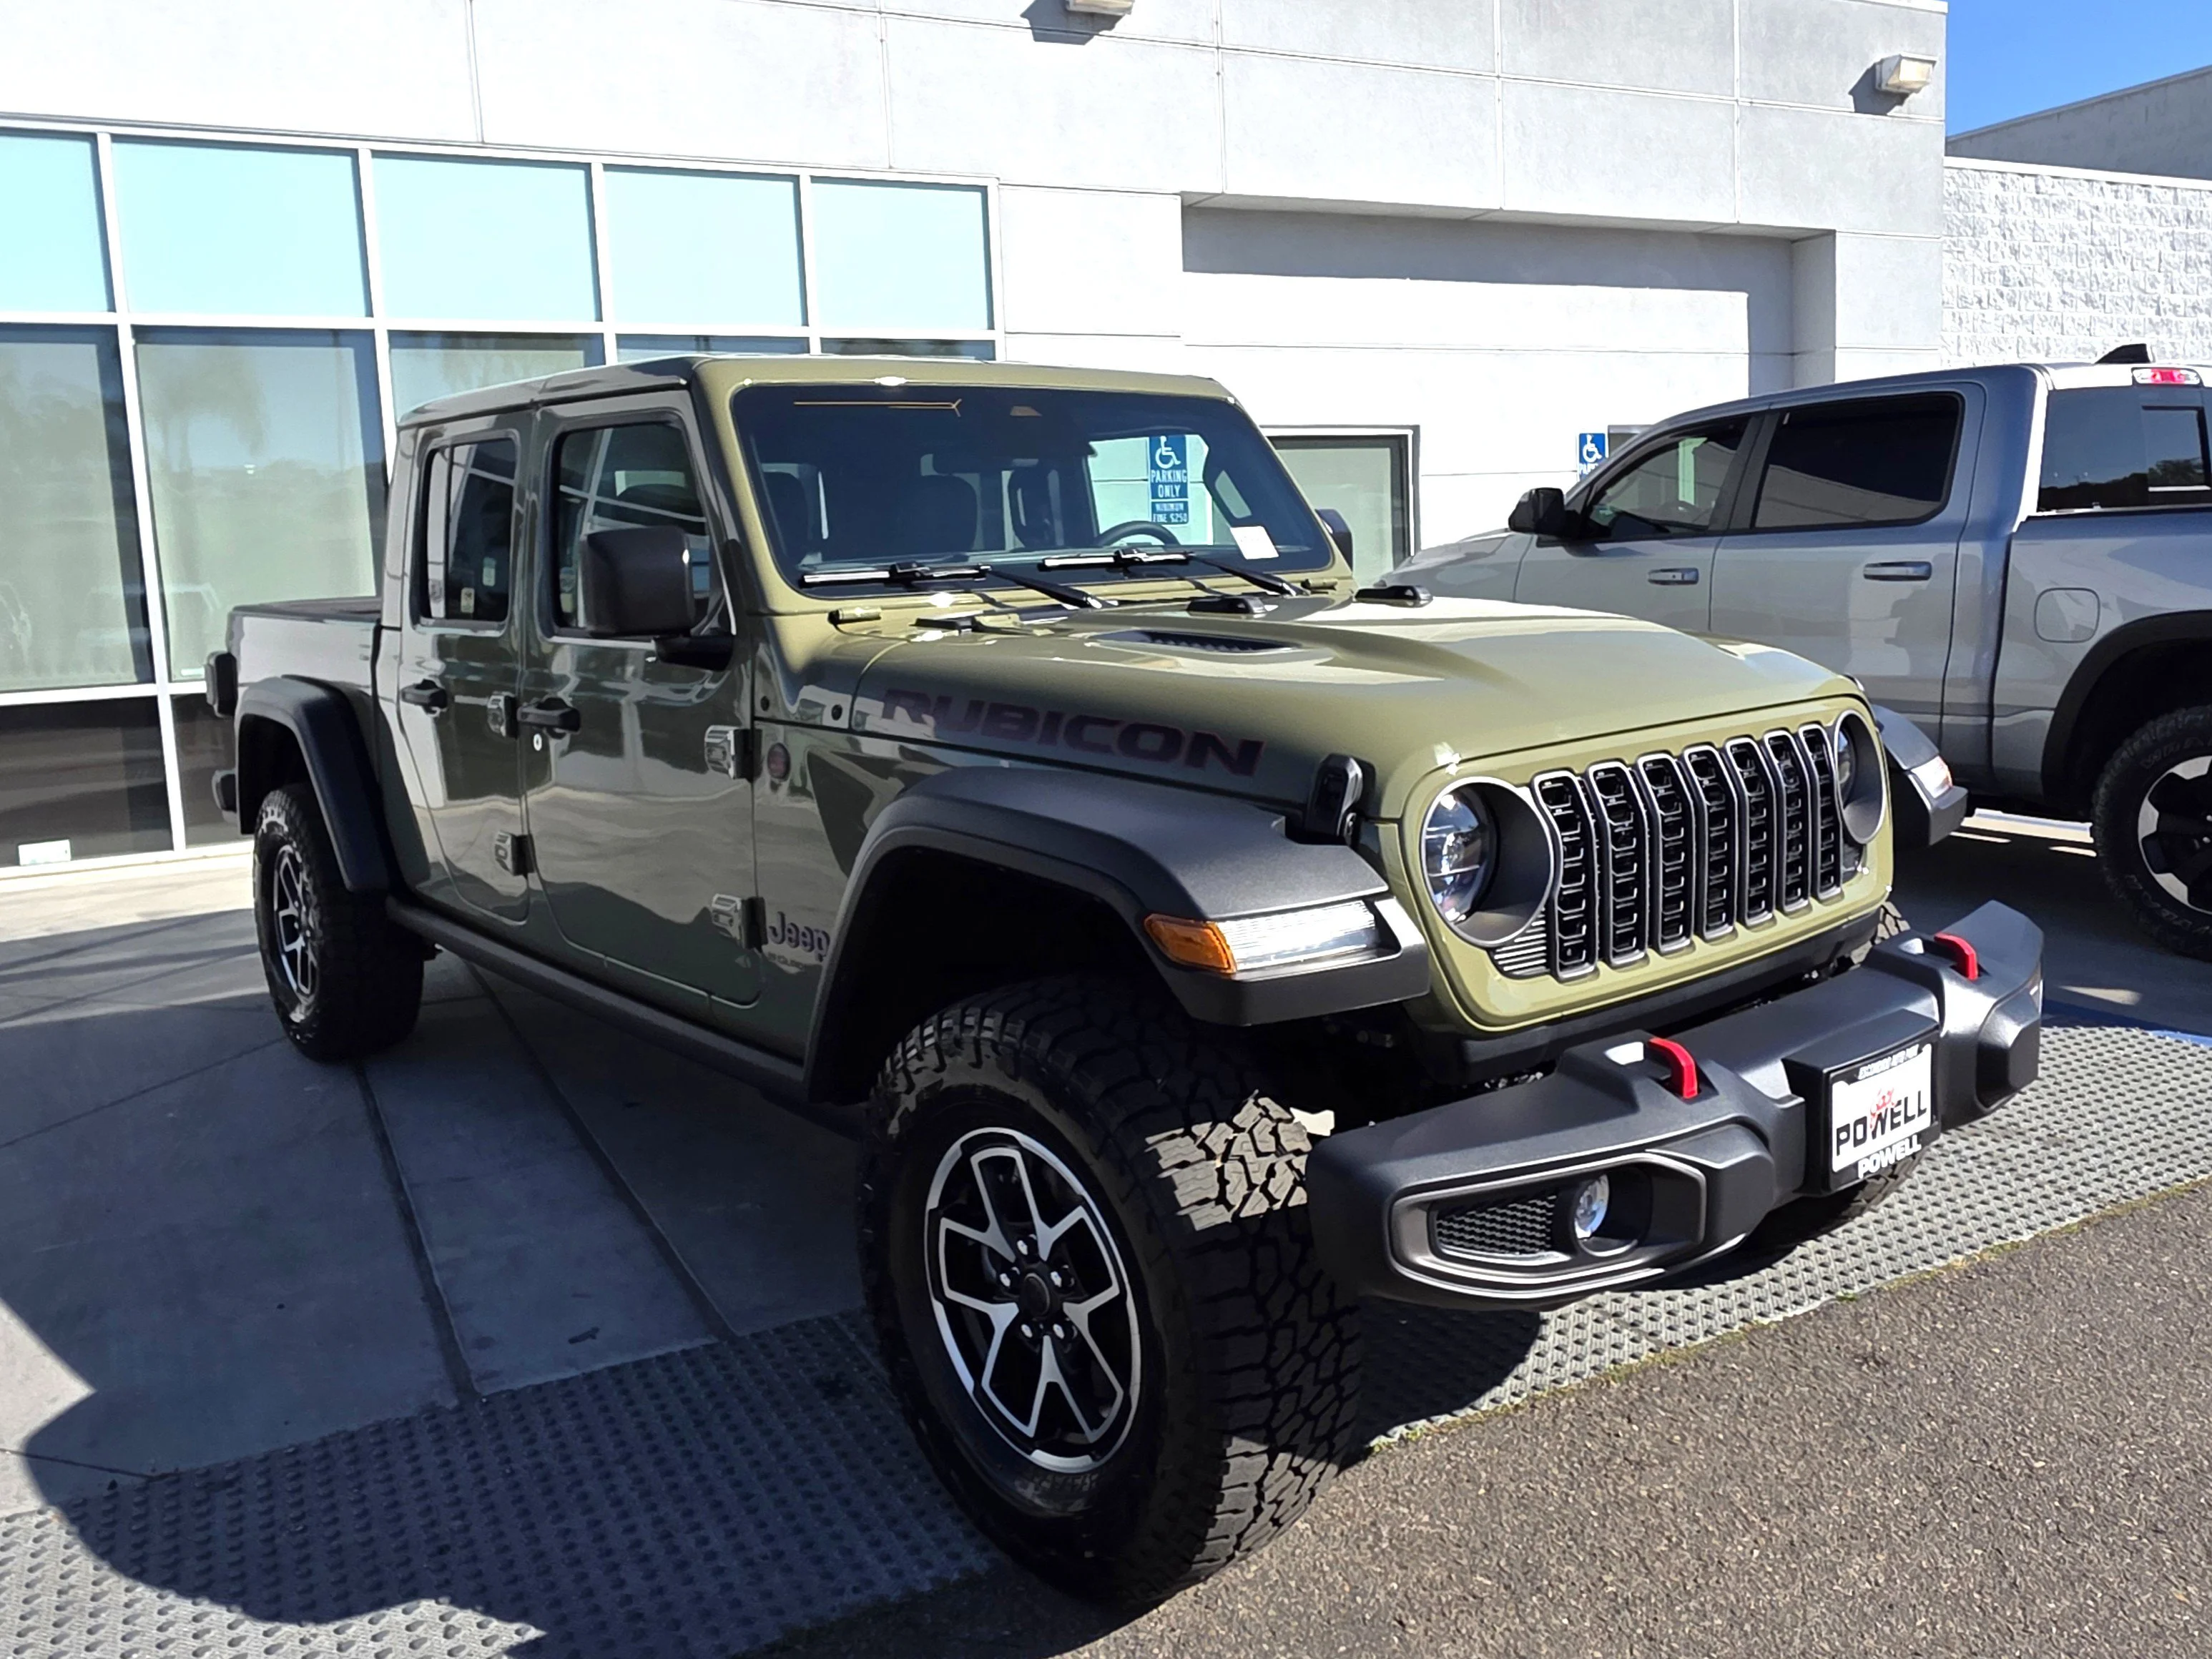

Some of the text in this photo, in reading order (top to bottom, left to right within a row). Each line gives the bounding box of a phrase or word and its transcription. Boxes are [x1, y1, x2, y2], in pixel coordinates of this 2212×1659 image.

[1151, 469, 1187, 483] PARKING
[1158, 484, 1181, 498] ONLY
[882, 688, 1267, 777] RUBICON
[768, 911, 830, 963] Jeep
[1836, 1090, 1927, 1156] POWELL
[1858, 1134, 1922, 1179] POWELL
